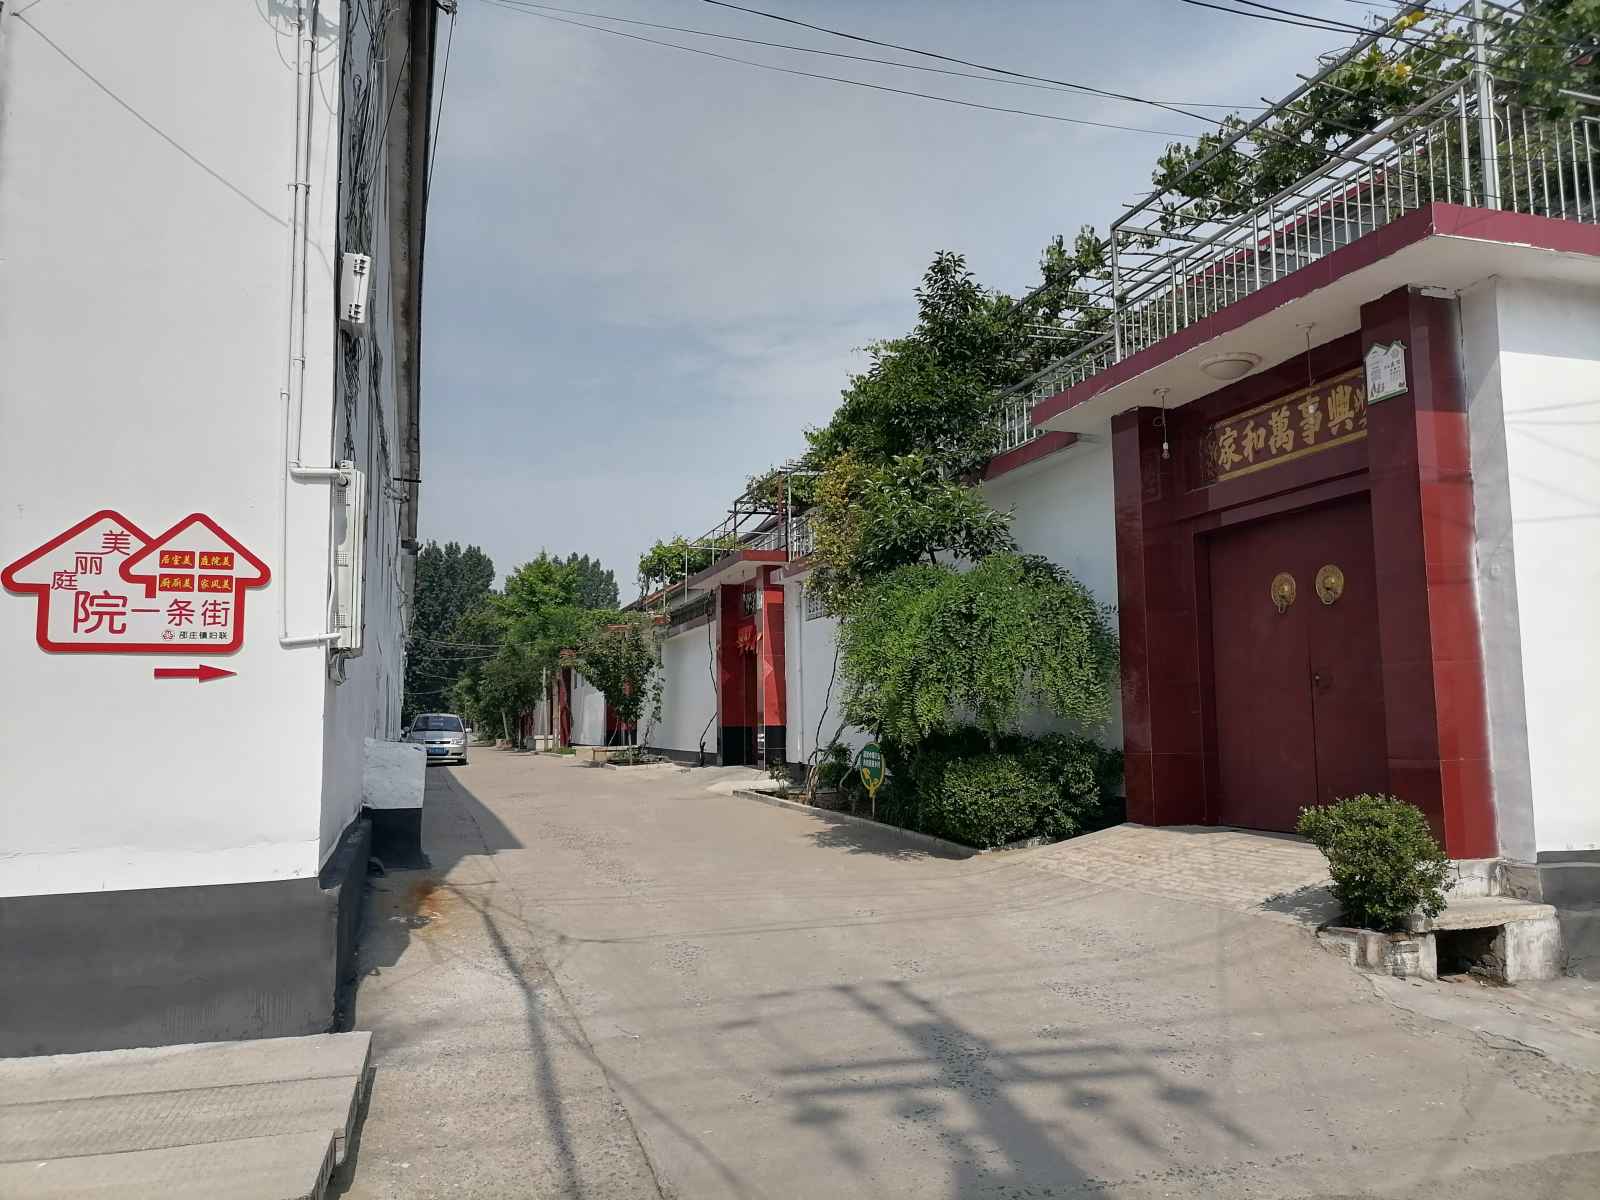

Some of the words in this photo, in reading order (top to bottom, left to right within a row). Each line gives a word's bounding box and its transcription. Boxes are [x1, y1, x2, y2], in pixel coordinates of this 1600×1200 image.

[161, 554, 193, 566] 居室美
[200, 554, 231, 567] 庭院美
[200, 578, 231, 590] 家风美
